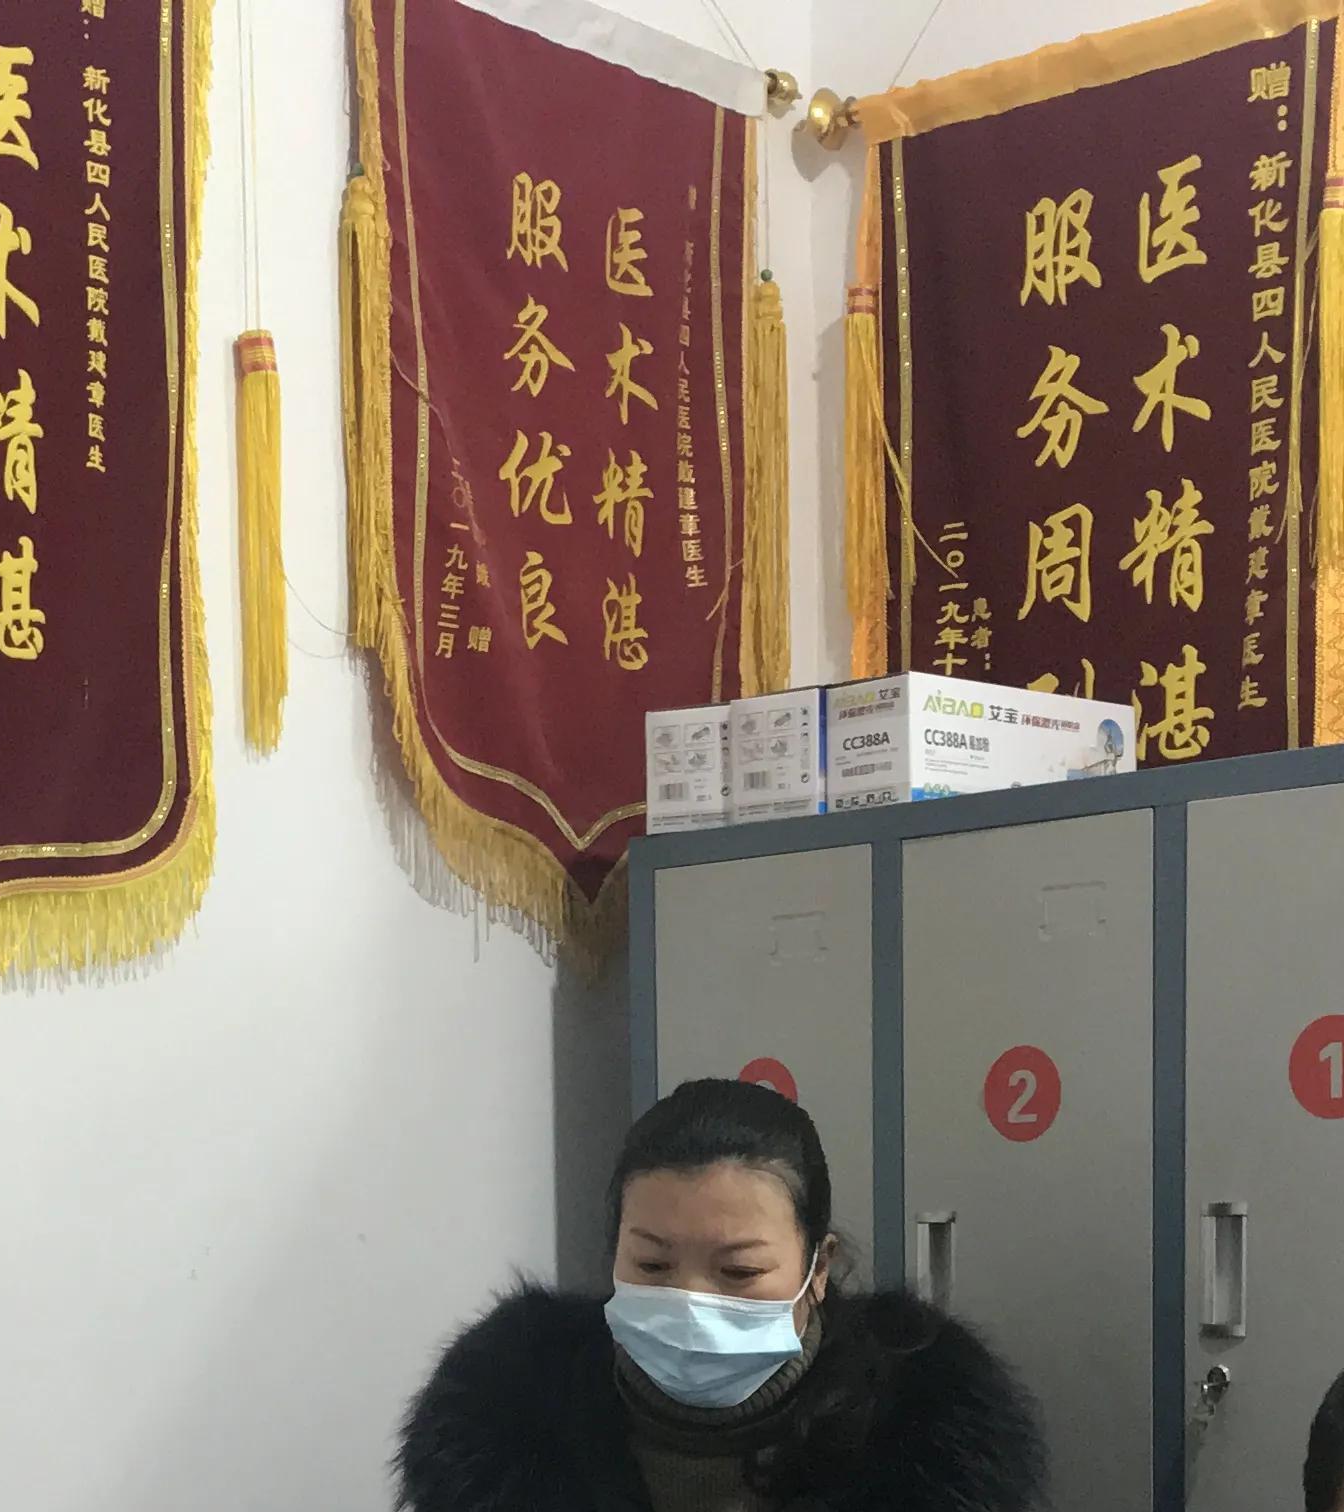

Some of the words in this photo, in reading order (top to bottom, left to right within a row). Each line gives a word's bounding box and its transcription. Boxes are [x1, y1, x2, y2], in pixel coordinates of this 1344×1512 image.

[498, 171, 576, 651] 服务优良
[593, 206, 658, 671] 医术精湛
[1119, 154, 1216, 761] 医术精湛
[842, 731, 890, 751] CC388A
[923, 728, 968, 750] CC388A
[1007, 1069, 1037, 1124] 2
[1319, 1041, 1344, 1100] 1
